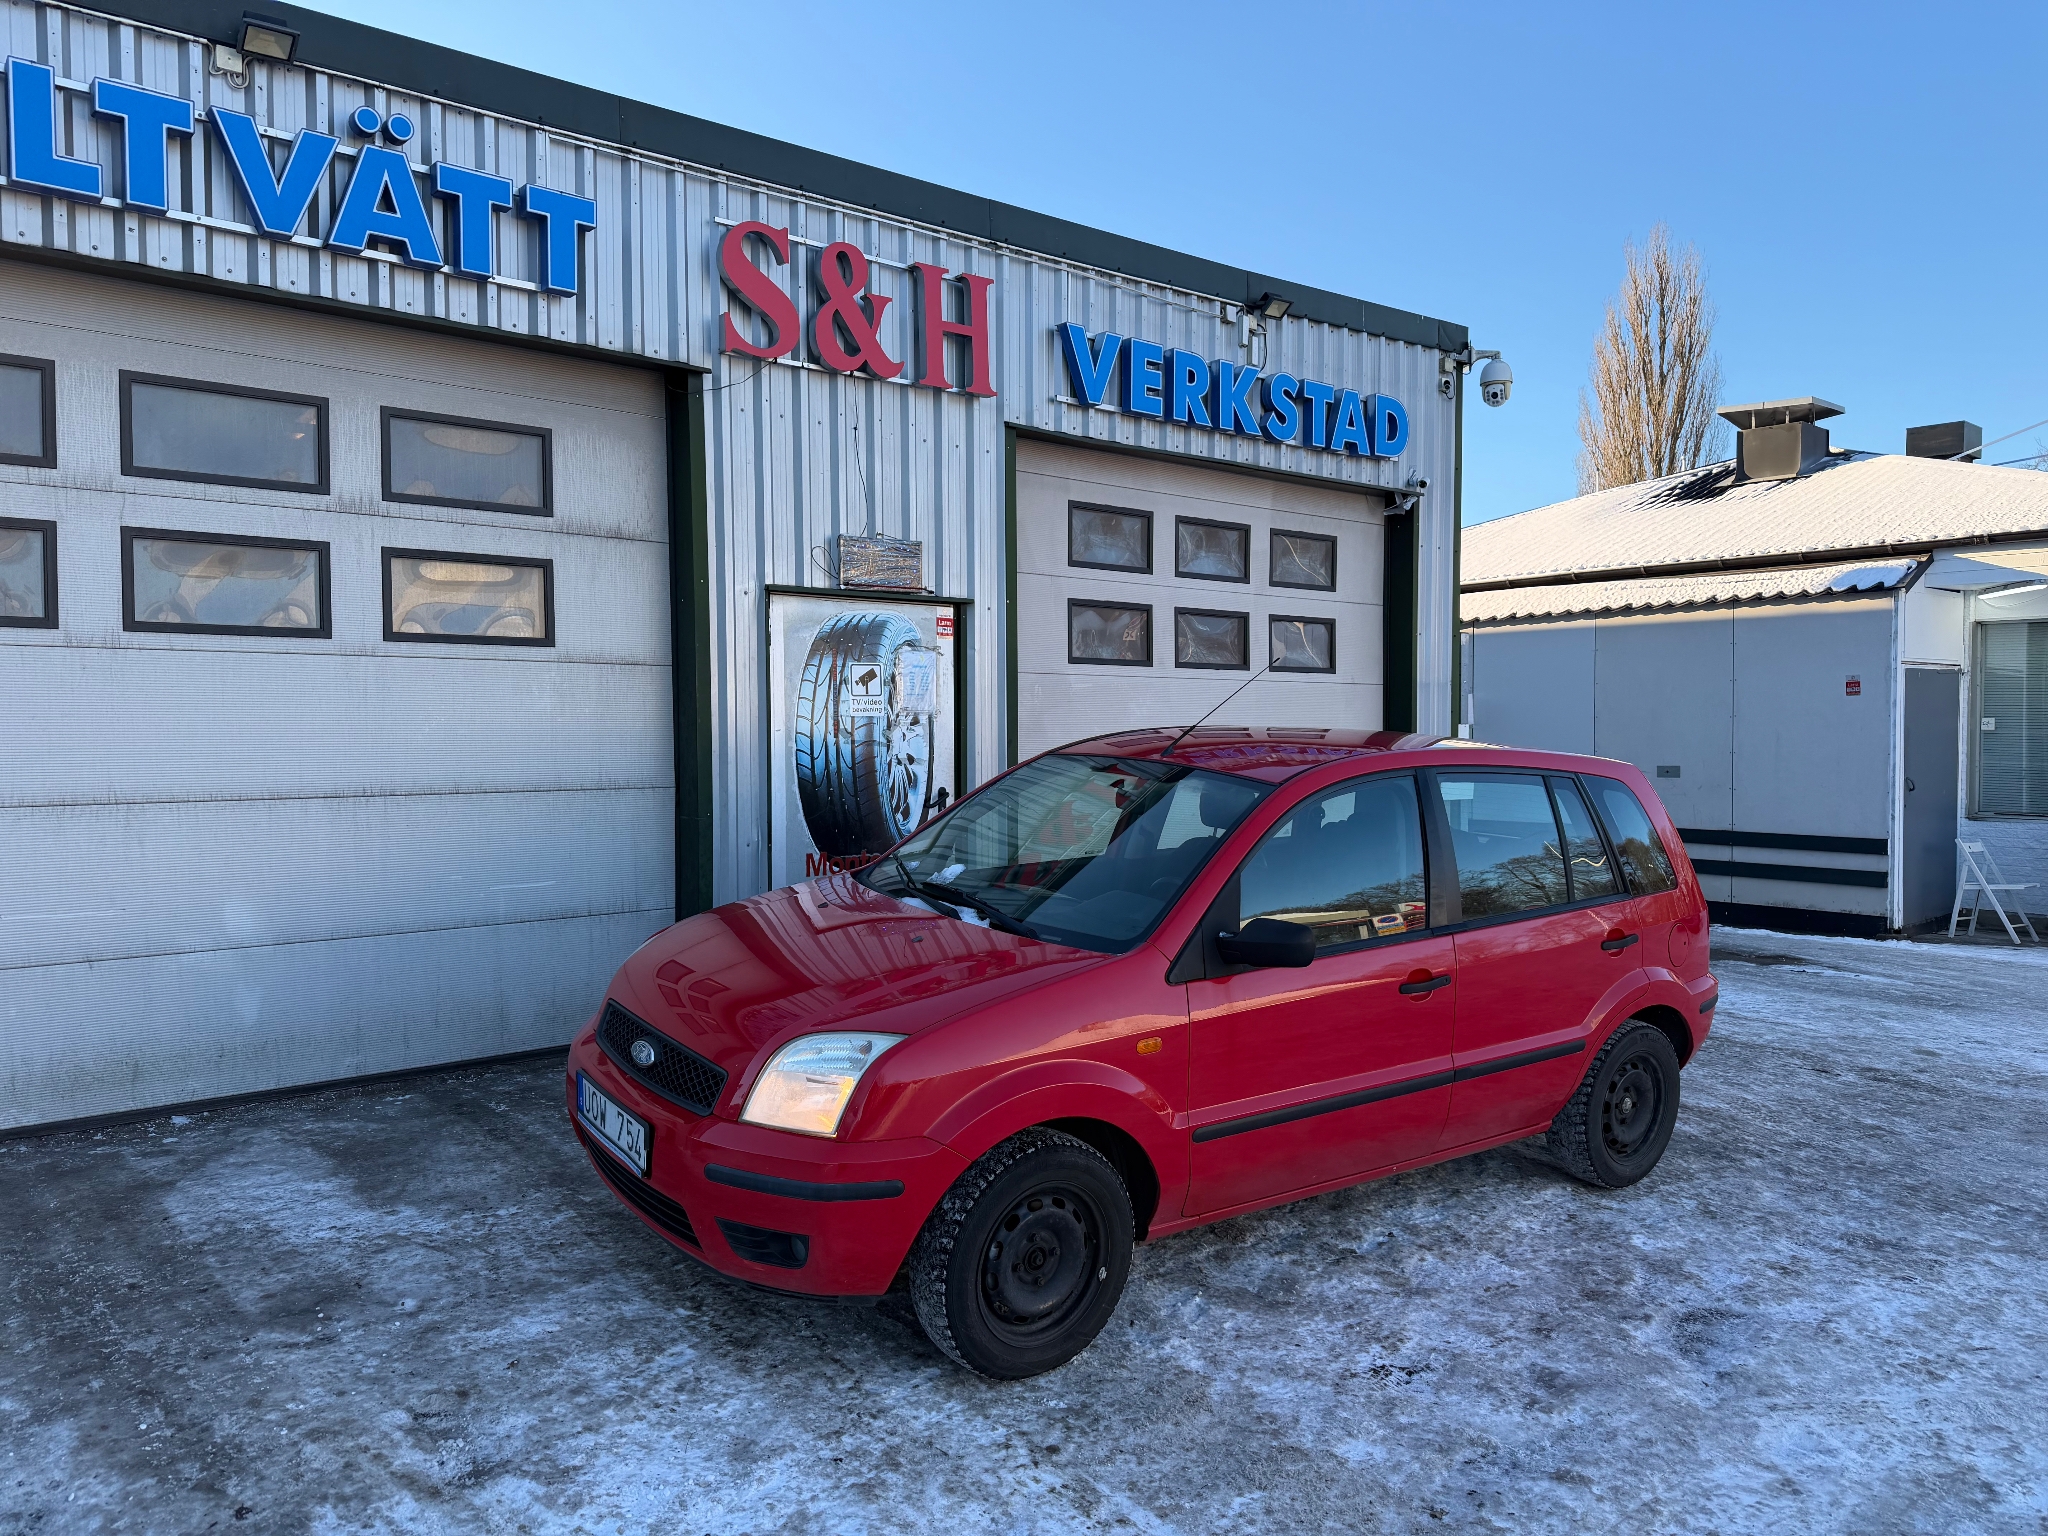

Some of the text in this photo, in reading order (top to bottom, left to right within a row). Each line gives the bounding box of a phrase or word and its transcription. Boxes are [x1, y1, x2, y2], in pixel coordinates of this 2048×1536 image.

[5, 55, 596, 298] LTVÄTT
[721, 220, 998, 397] S&H
[1059, 322, 1410, 459] VERKSTAD
[851, 698, 883, 706] TV/video
[584, 1082, 642, 1162] UOW 754
